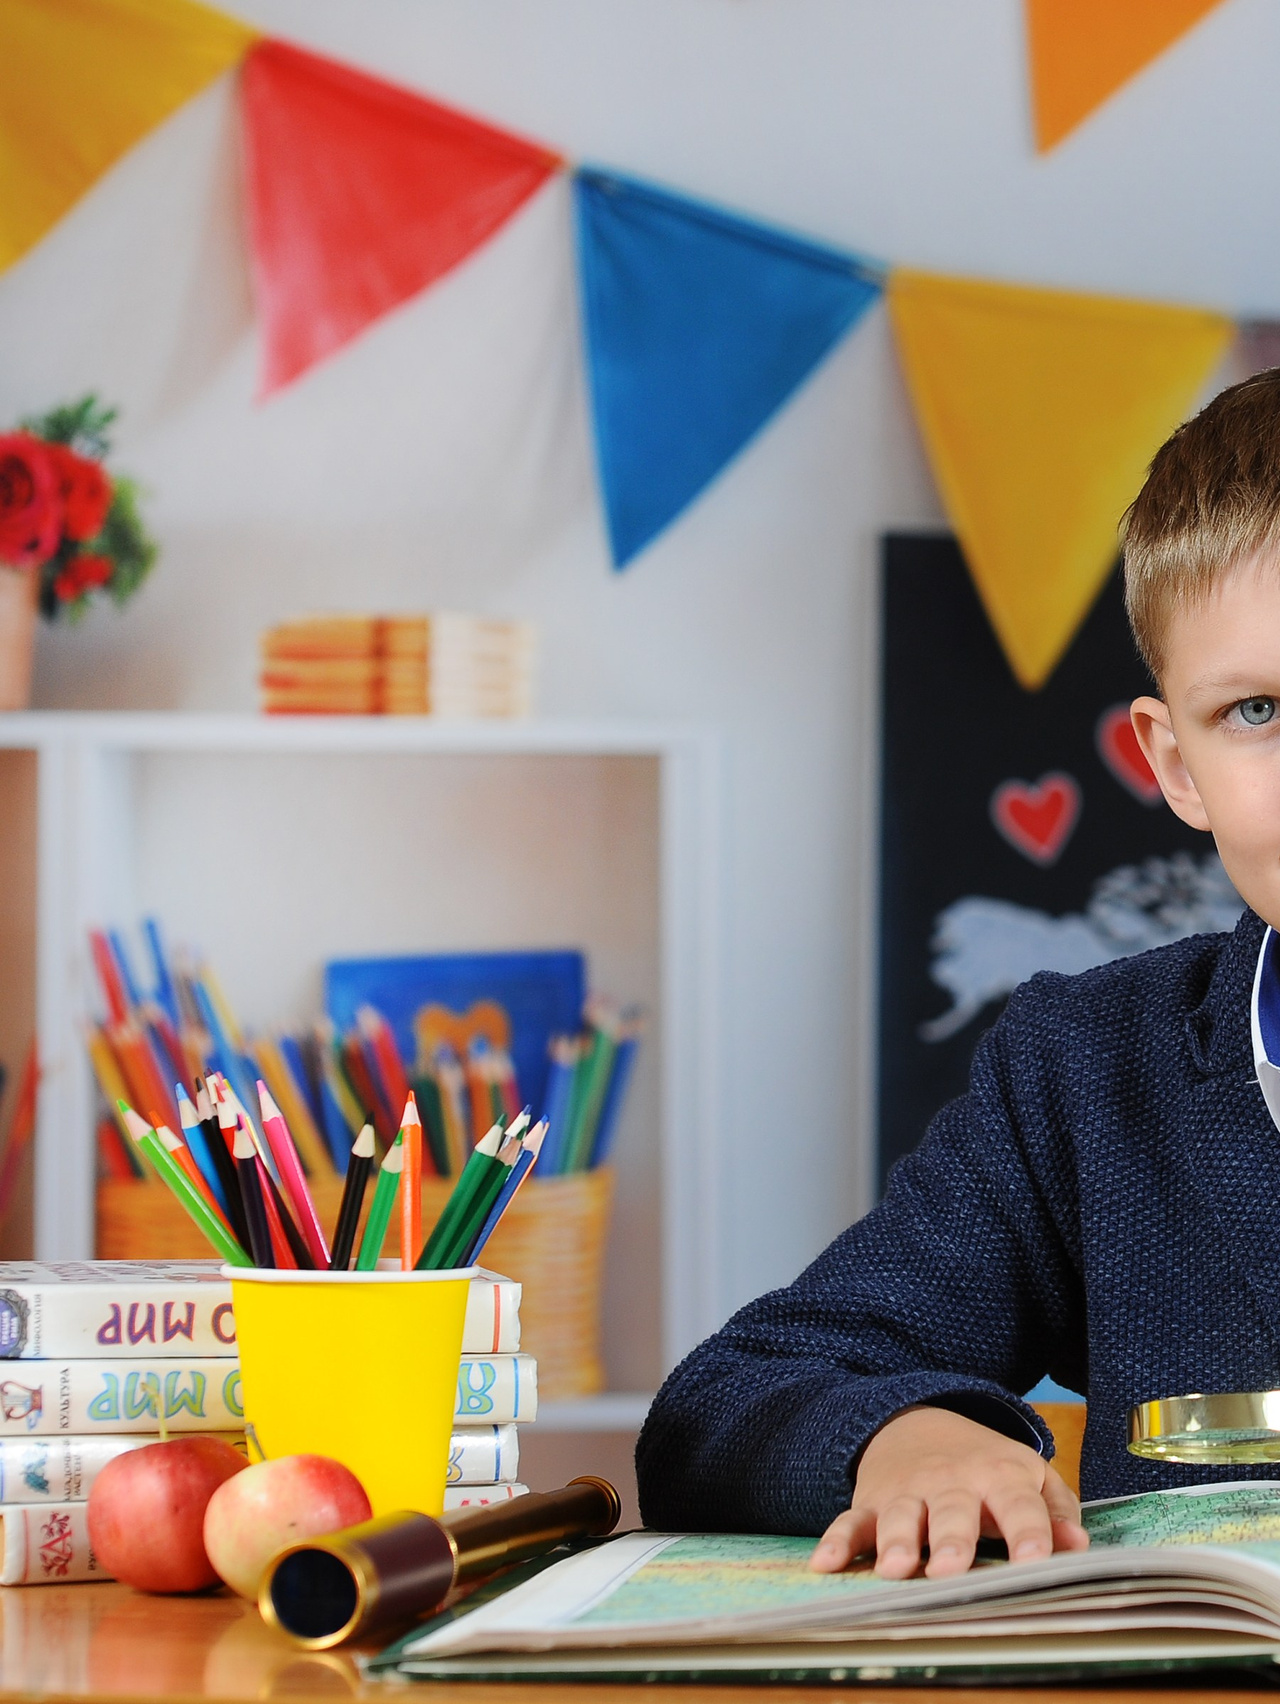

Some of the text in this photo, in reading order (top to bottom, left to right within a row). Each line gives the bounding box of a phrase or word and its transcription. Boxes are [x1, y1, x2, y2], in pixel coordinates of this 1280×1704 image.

[96, 1302, 196, 1345] МИР
[60, 1367, 70, 1429] КУЛЬТУРА
[88, 1370, 206, 1421] МИР
[456, 1362, 496, 1415] Я
